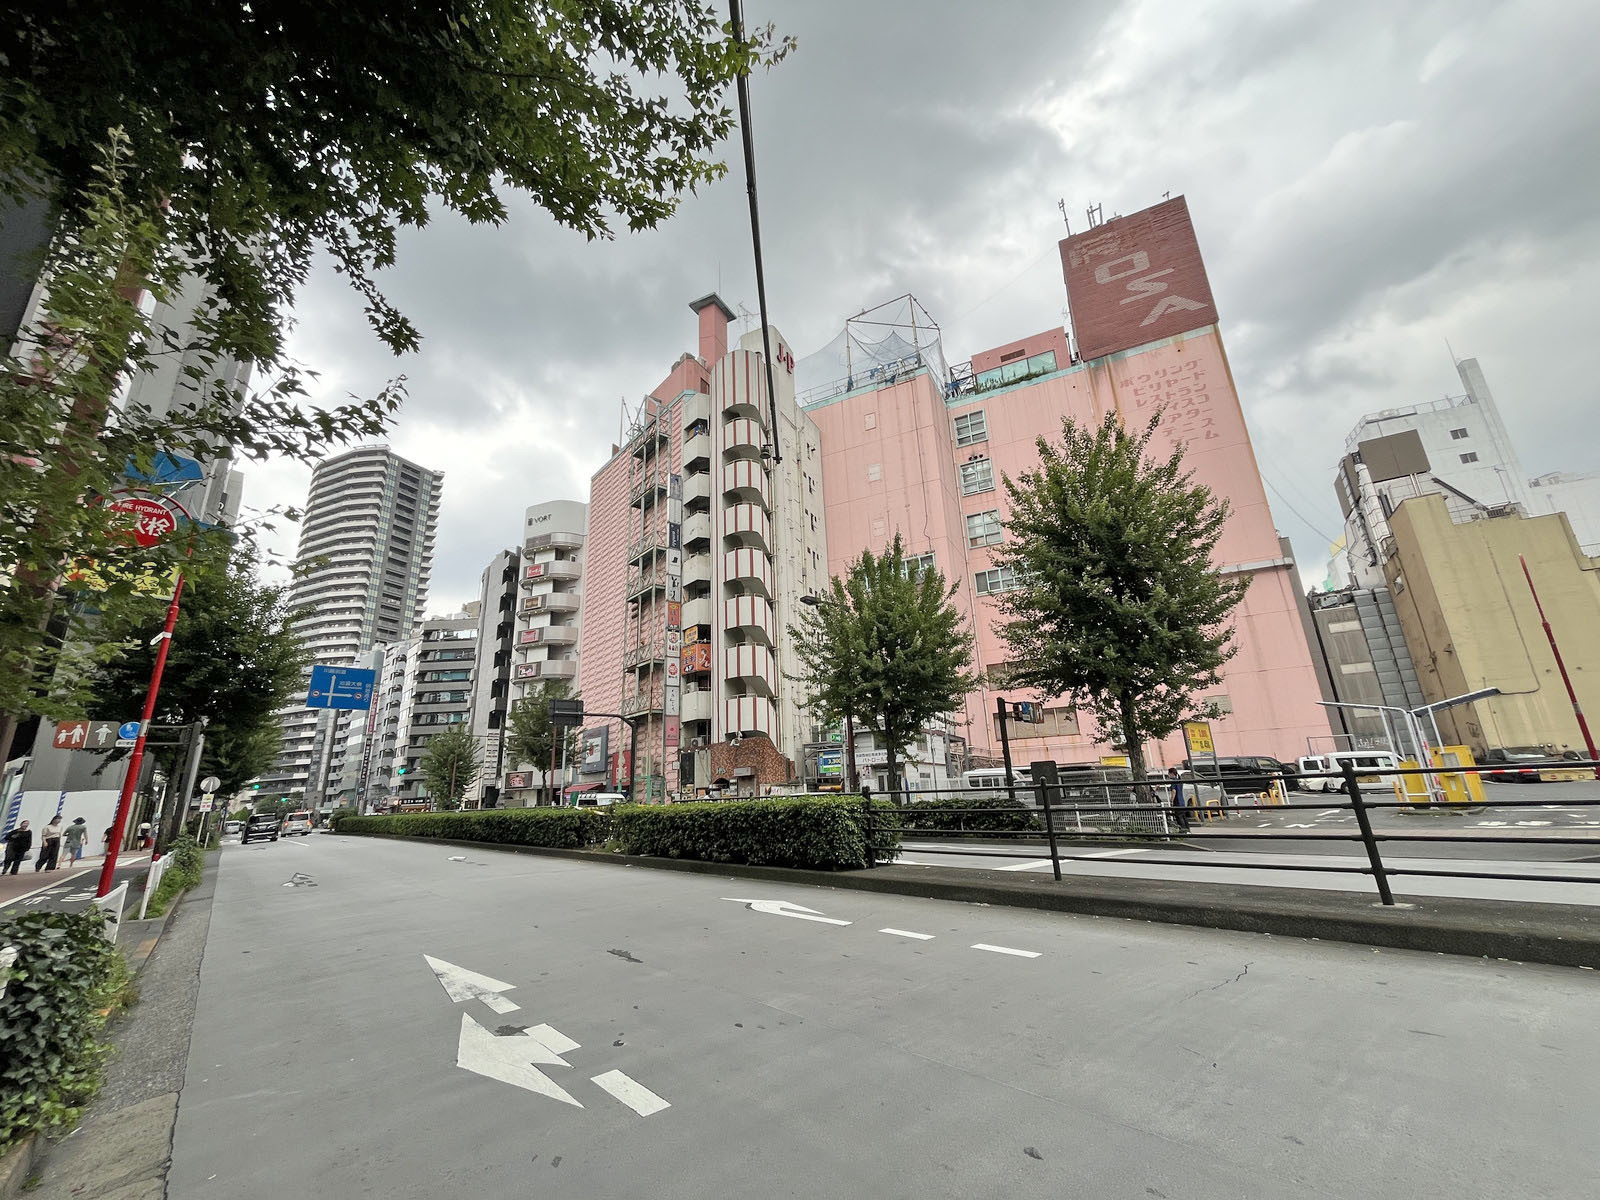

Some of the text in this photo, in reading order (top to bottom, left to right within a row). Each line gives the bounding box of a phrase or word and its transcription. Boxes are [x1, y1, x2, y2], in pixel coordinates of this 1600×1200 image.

[1120, 359, 1203, 389] ボウリング
[1133, 369, 1206, 396] ビリヤード
[1135, 383, 1207, 408] レストラン
[117, 502, 167, 515] FIRE HYDRANT
[534, 513, 552, 523] VORT
